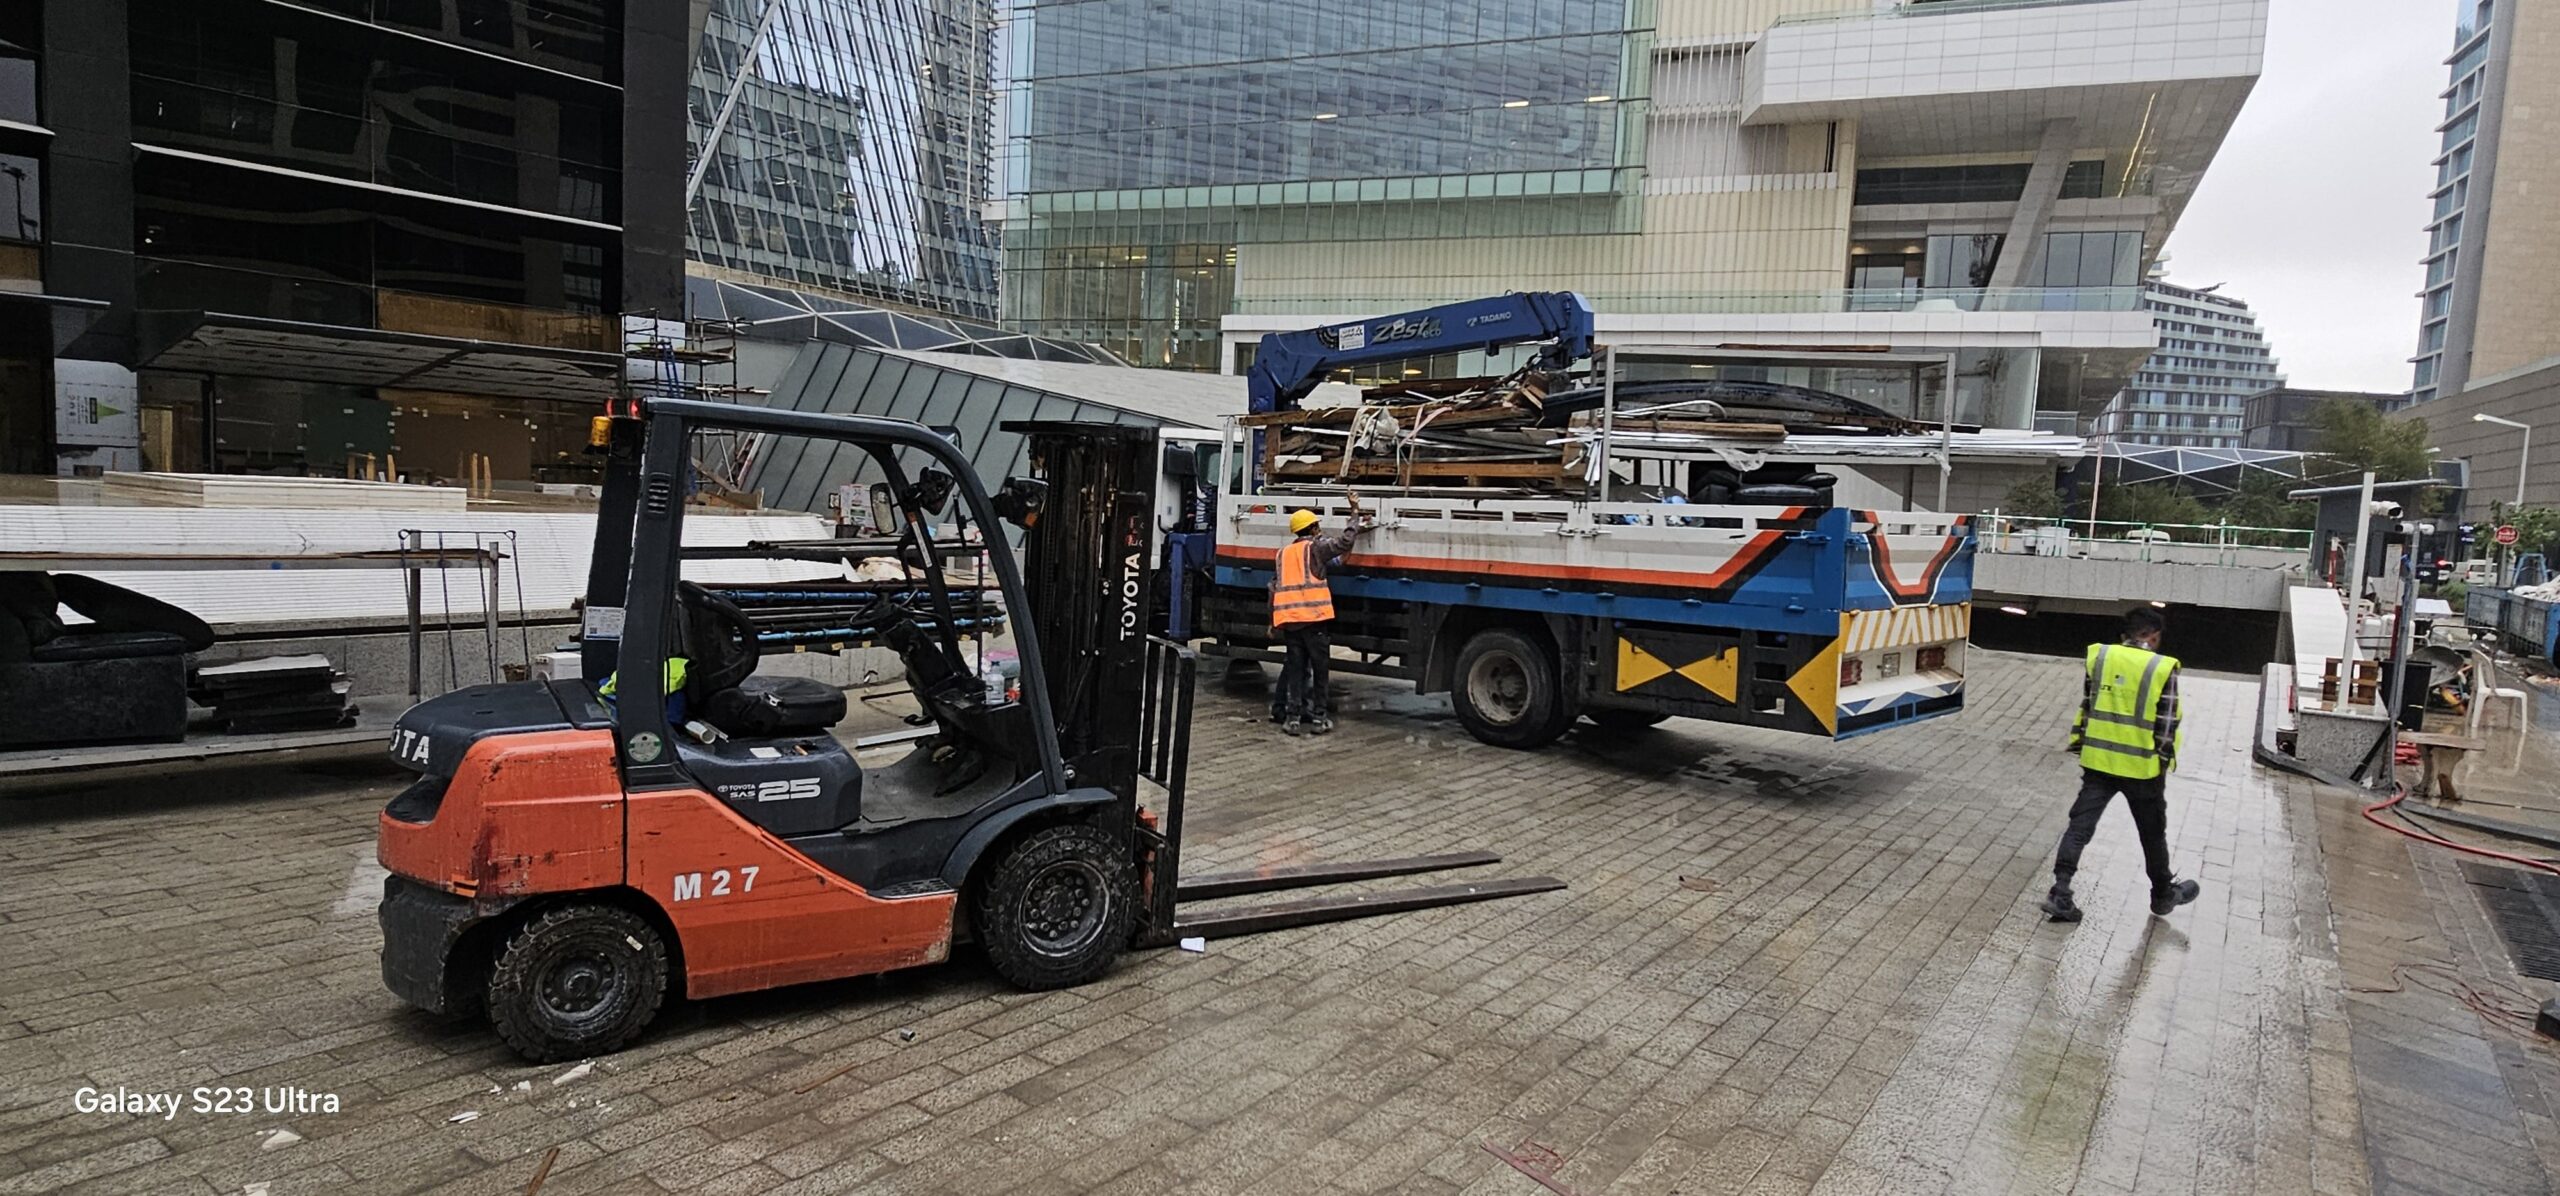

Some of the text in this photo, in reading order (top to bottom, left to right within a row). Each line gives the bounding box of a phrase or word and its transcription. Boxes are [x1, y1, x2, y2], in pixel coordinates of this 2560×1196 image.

[1480, 311, 1512, 324] TADANO
[1422, 327, 1442, 339] eco
[1120, 552, 1141, 641] TOYOTA
[729, 783, 756, 791] TOYOTA
[758, 777, 821, 803] 25
[729, 790, 756, 799] SAS
